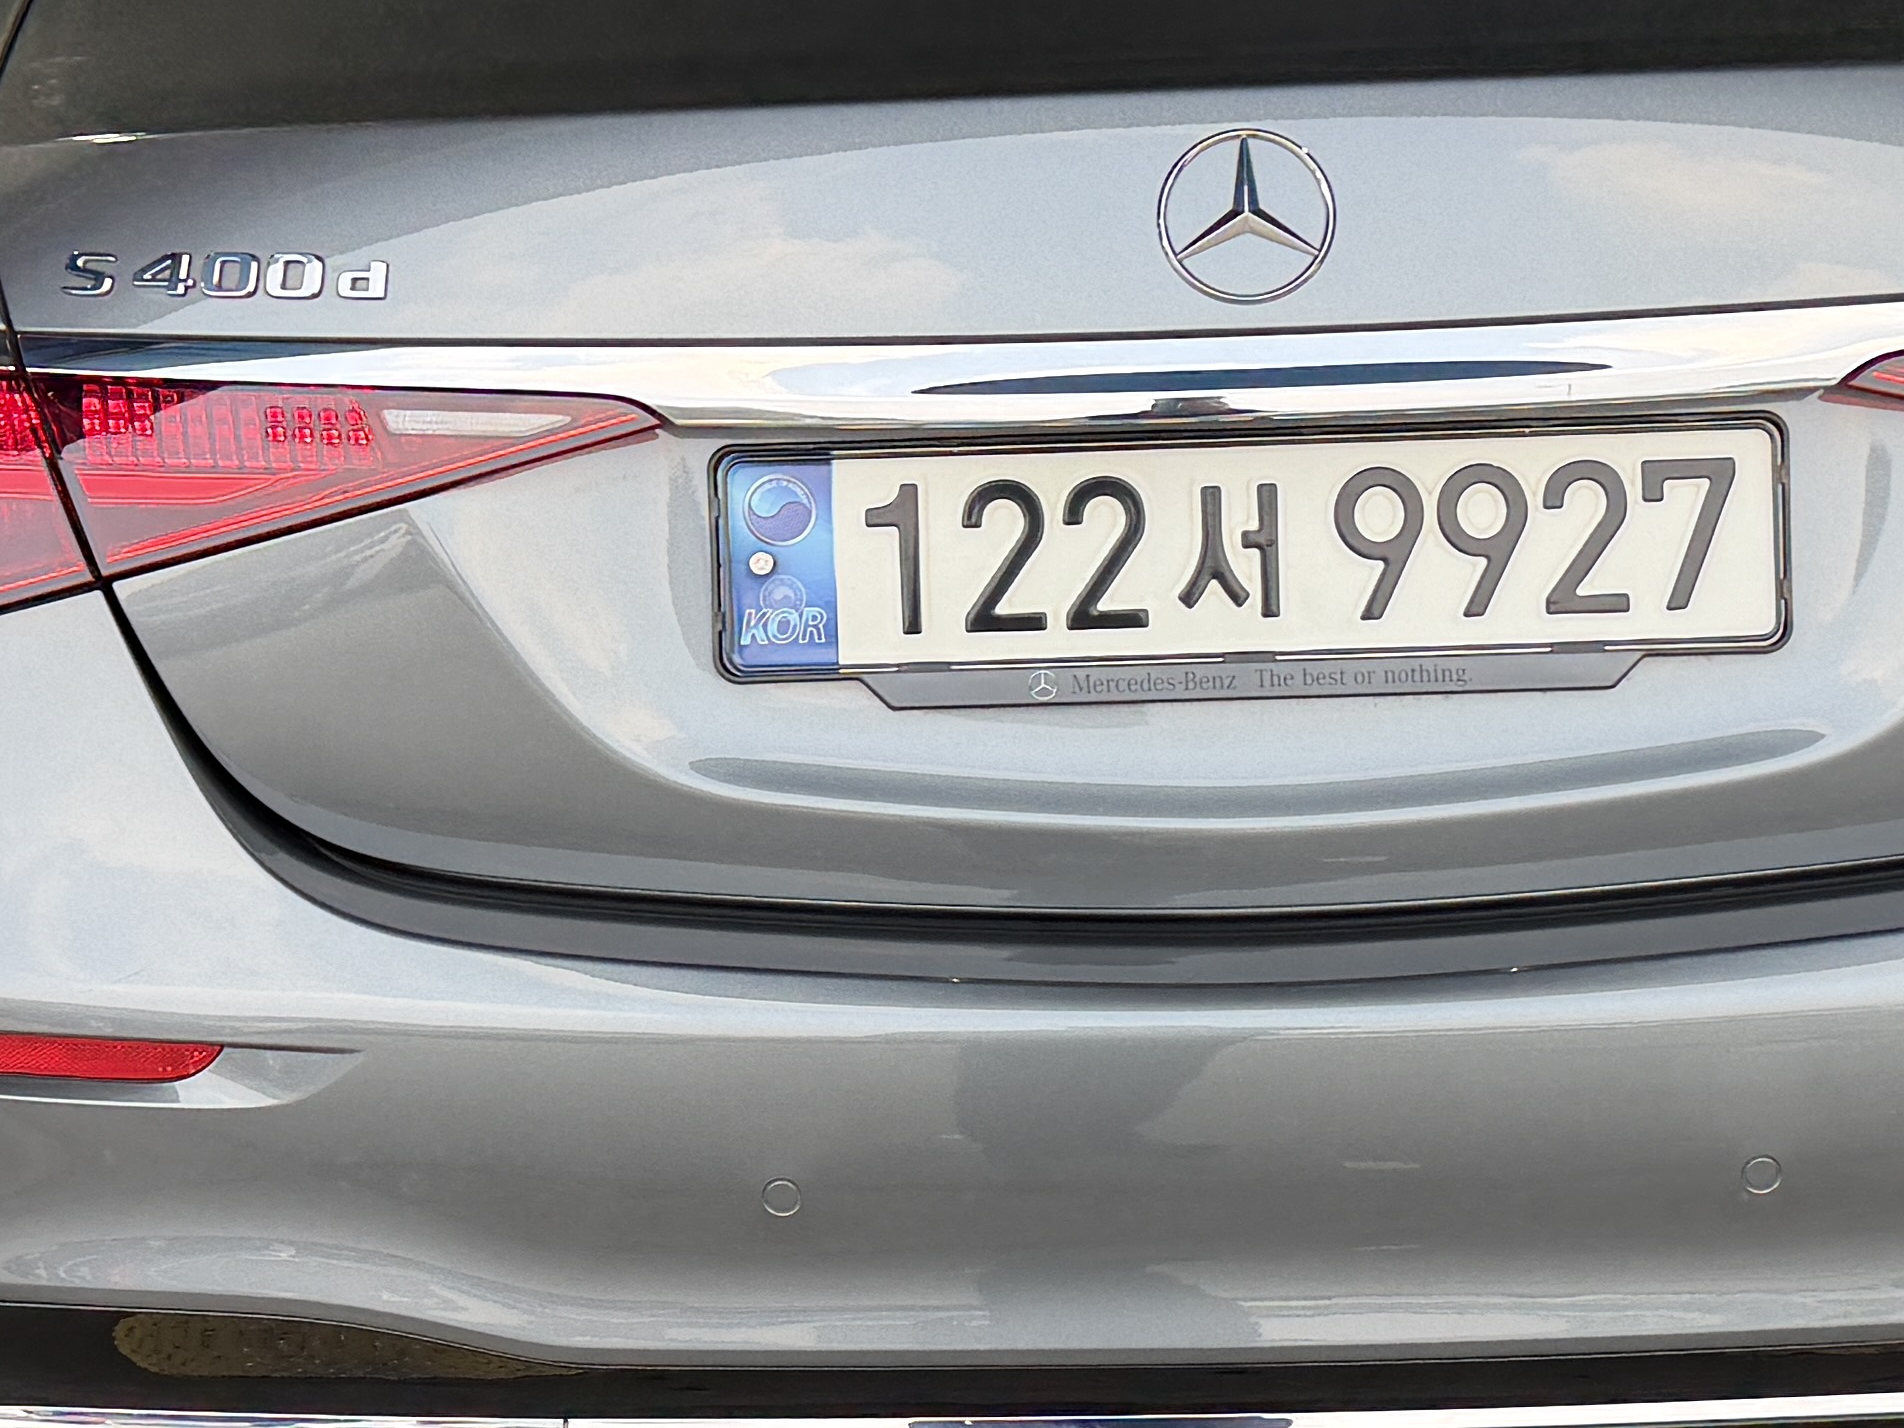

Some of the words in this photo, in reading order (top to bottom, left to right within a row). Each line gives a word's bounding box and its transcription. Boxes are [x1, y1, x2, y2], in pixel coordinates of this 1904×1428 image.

[864, 476, 1281, 636] 122서
[1334, 458, 1736, 621] 9927
[740, 607, 827, 645] KOR
[1071, 670, 1238, 695] Mercedes-Benz
[1255, 666, 1295, 689] The
[1302, 663, 1348, 687] best
[1353, 668, 1376, 686] or
[1383, 663, 1474, 689] nothing.
